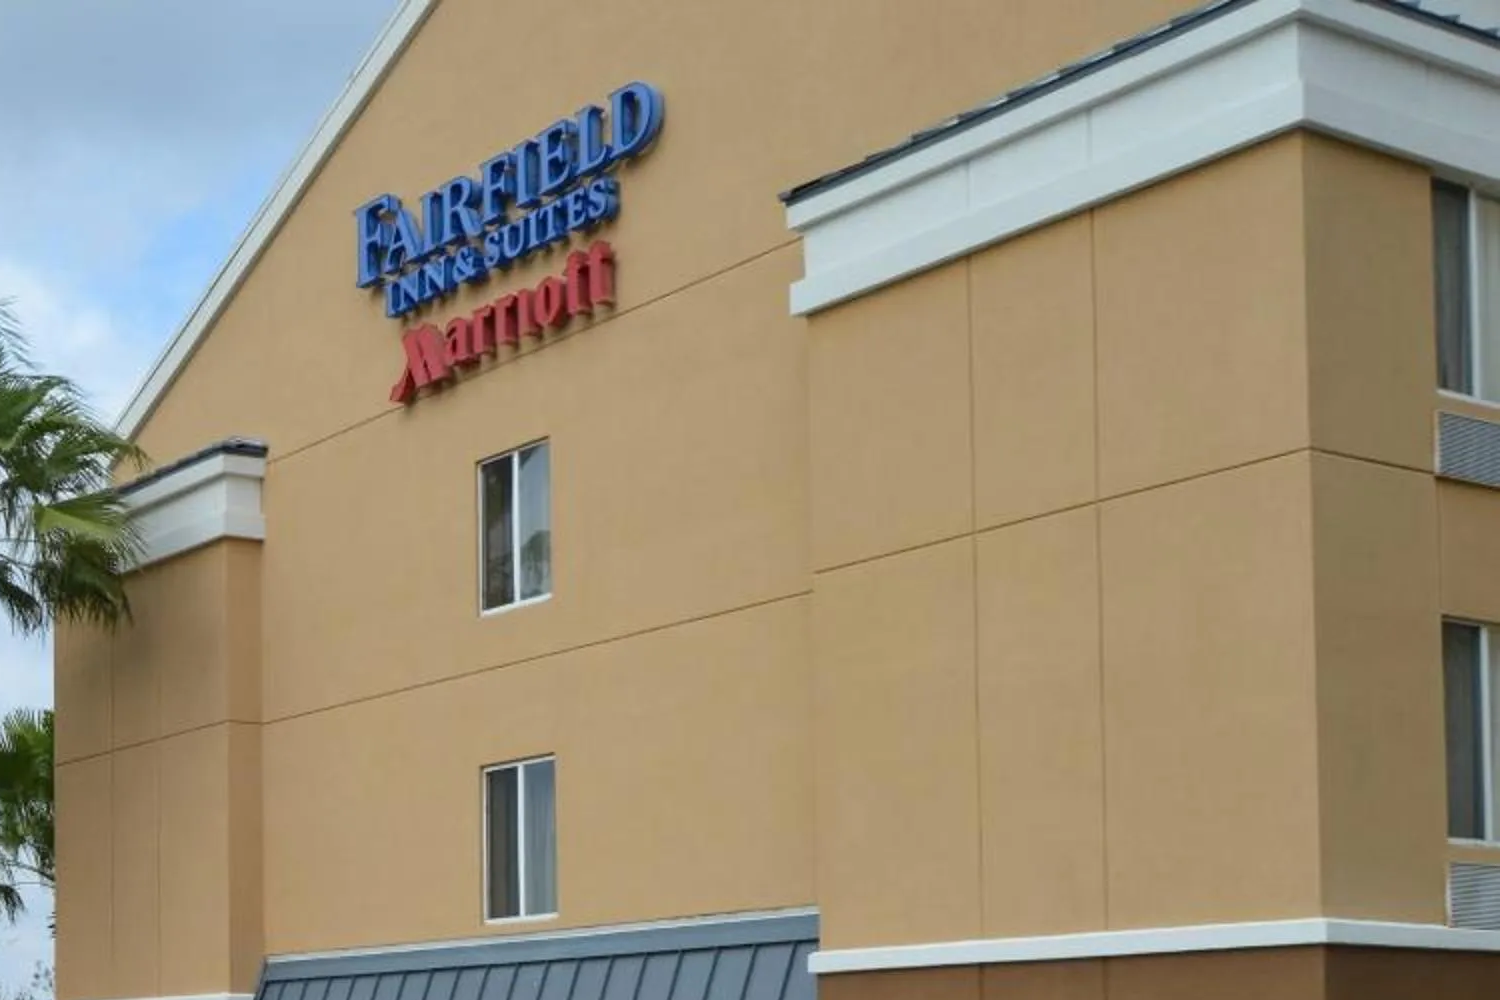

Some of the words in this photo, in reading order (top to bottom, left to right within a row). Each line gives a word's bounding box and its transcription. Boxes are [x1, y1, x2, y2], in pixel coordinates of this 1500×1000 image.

[354, 80, 666, 290] FAIRFIELD
[384, 256, 452, 320] INN
[450, 244, 488, 287] &
[482, 176, 621, 270] SUITES
[389, 240, 617, 404] Marriott
